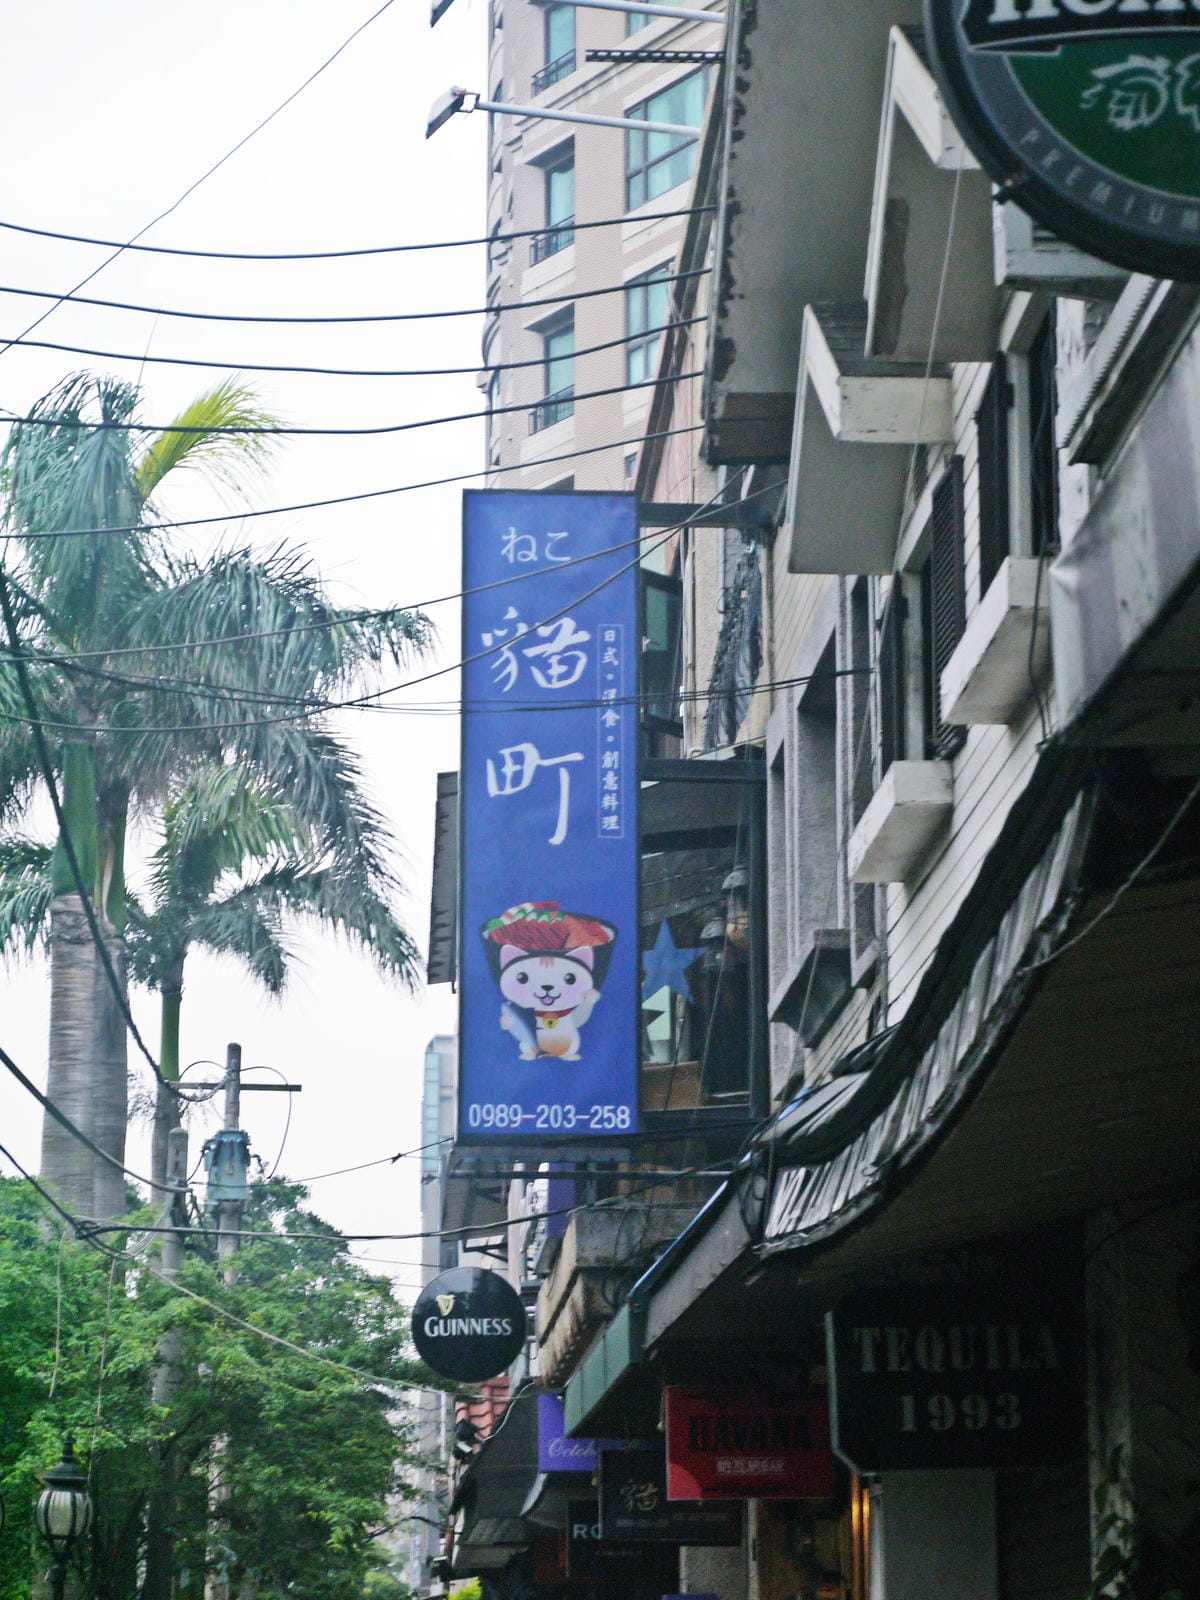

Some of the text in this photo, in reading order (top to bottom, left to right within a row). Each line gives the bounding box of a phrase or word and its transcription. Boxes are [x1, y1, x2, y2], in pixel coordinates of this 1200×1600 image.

[500, 526, 572, 563] ねこ
[468, 1103, 631, 1130] 0989-203-258
[853, 1325, 1060, 1373] TEQUILA
[900, 1393, 1023, 1432] 1993
